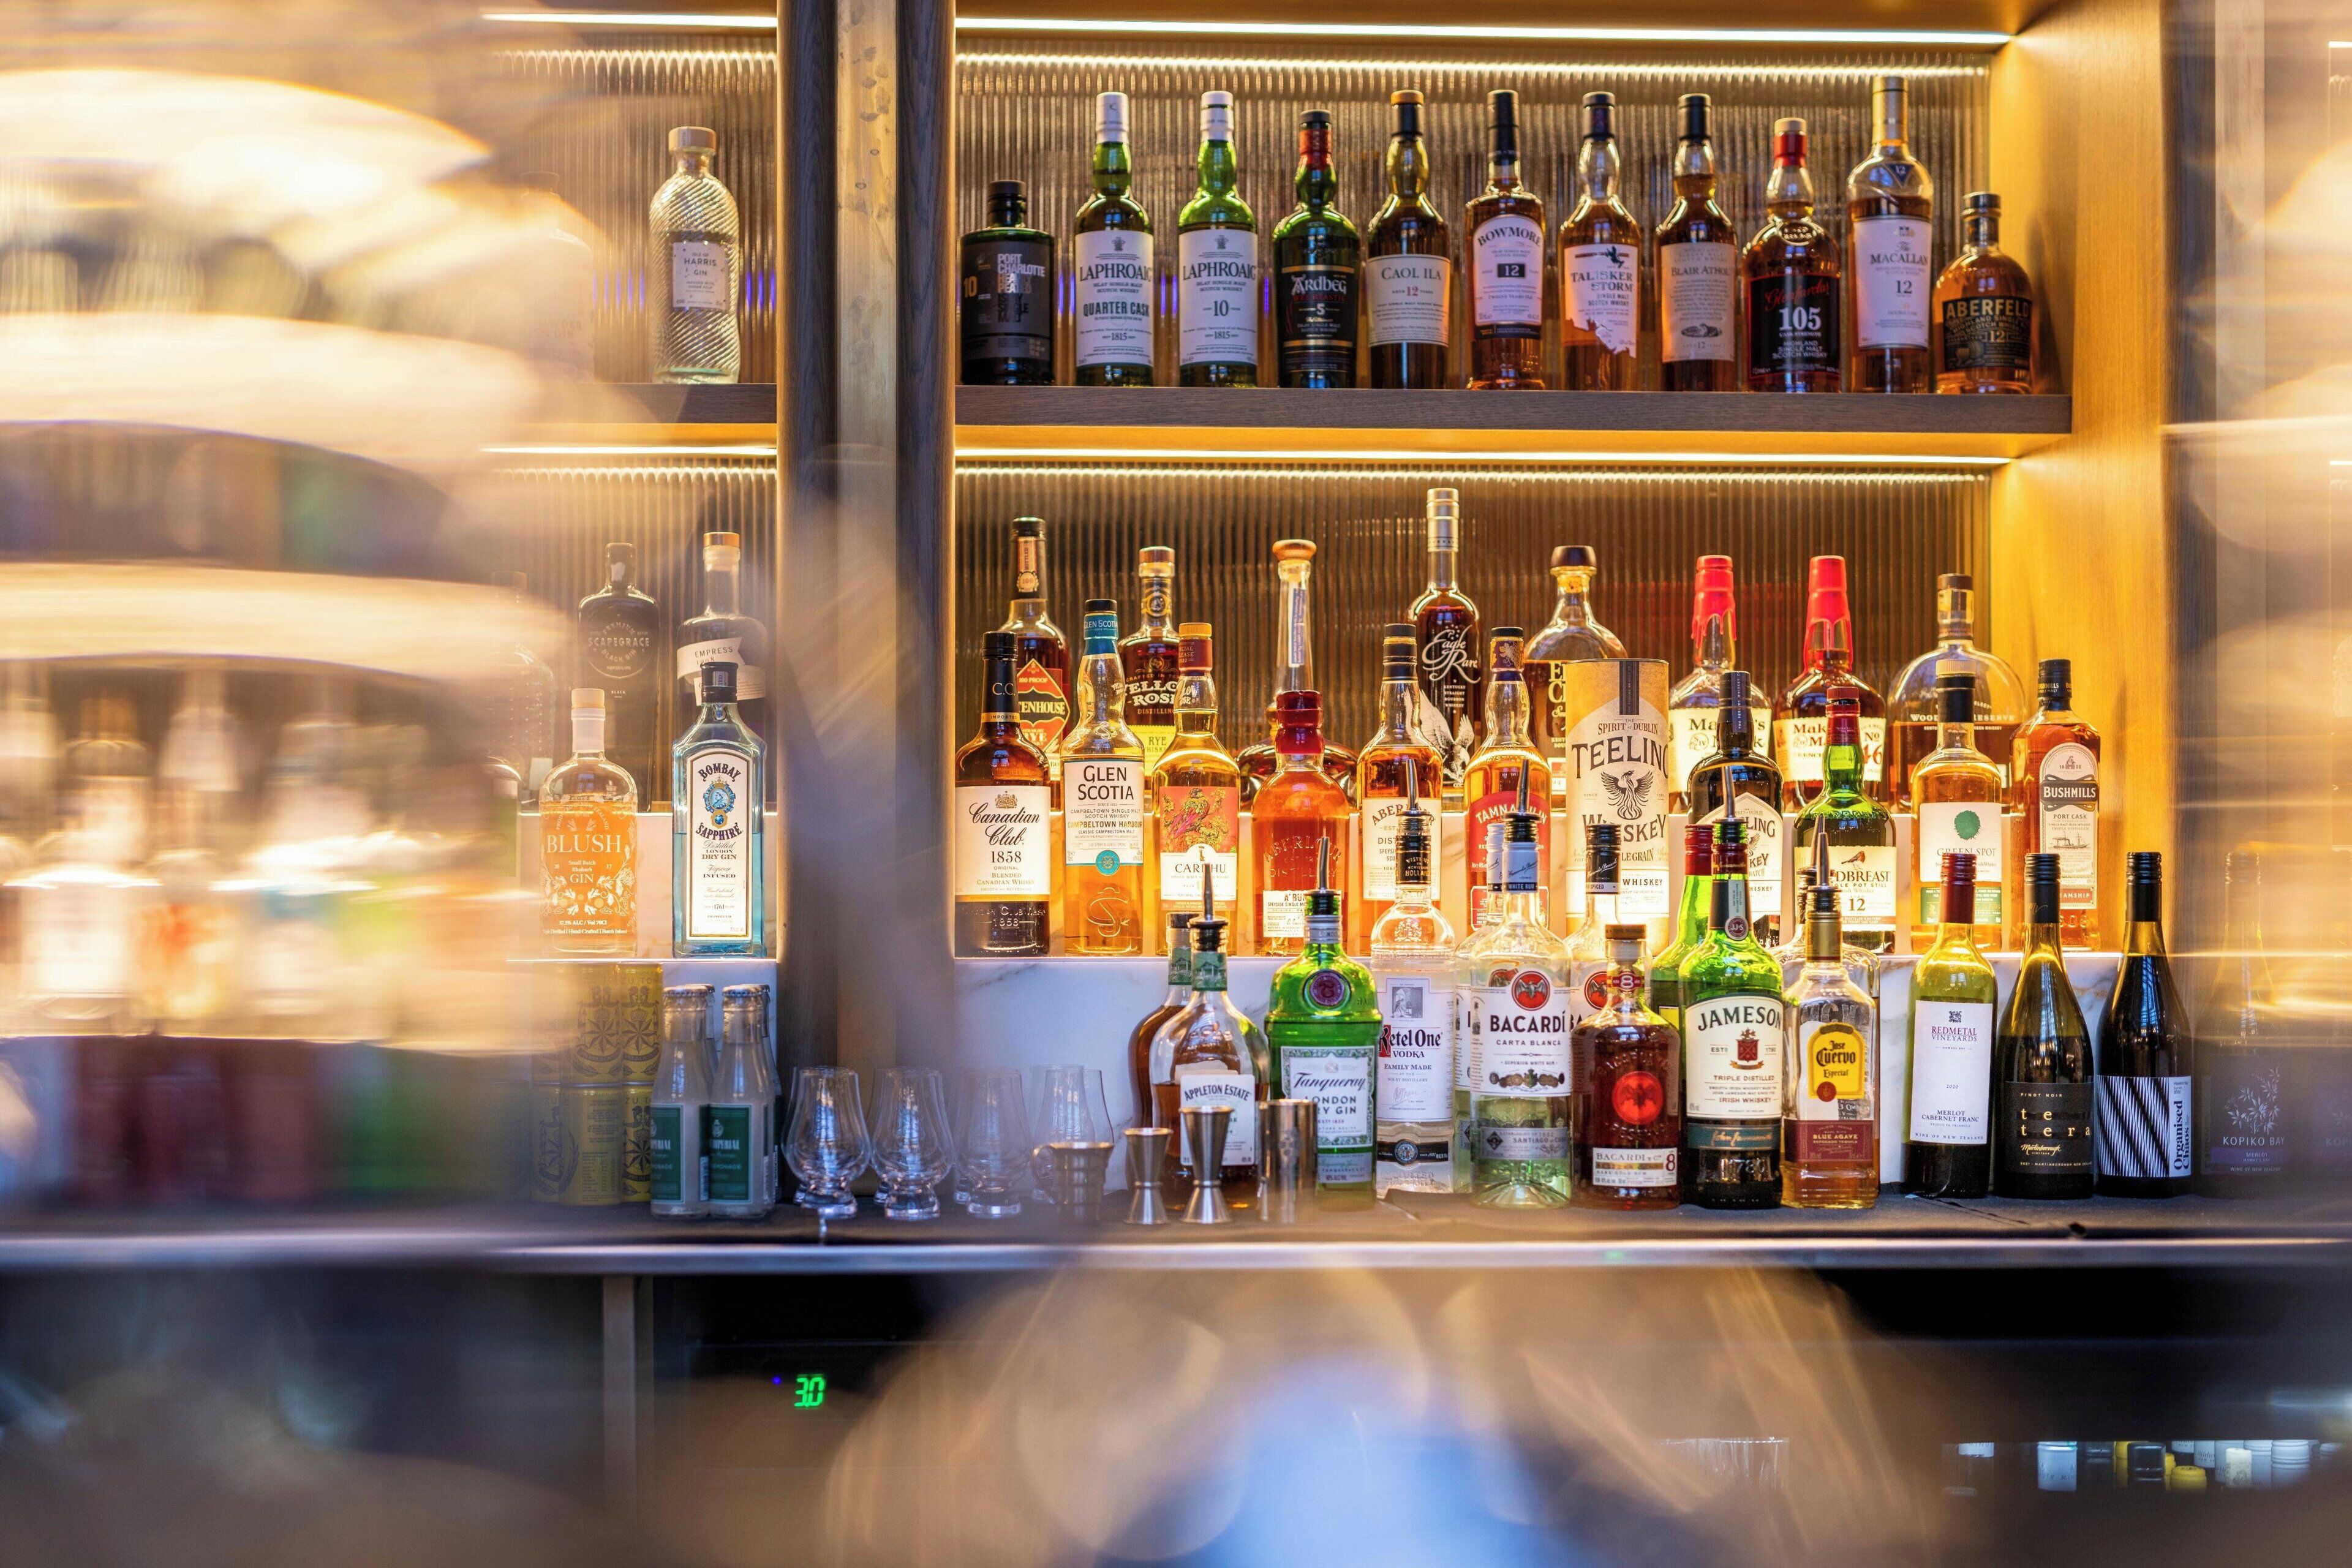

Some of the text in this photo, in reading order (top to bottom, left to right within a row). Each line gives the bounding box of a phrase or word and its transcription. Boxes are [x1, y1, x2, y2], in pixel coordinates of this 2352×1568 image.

[1477, 226, 1541, 247] BOWMORE
[684, 258, 717, 266] HARRIS
[997, 253, 1022, 265] PORT
[997, 263, 1046, 277] CHARLOTTE
[1381, 266, 1442, 281] CAOL ILA
[1504, 265, 1520, 276] 12
[1570, 270, 1634, 283] TALISKER
[1672, 266, 1700, 277] BLAIR
[963, 275, 978, 298] 10
[1406, 286, 1419, 296] 12
[1591, 281, 1634, 293] STORM
[1896, 280, 1913, 294] 12
[1083, 301, 1150, 317] QUARTER CASK
[1213, 300, 1229, 317] 10
[1316, 303, 1326, 315] 5
[1946, 298, 2029, 319] ABERFELD
[1779, 306, 1822, 331] 105
[1111, 333, 1128, 341] 1815
[1213, 331, 1231, 339] 1815
[1990, 330, 2006, 343] 12
[587, 638, 649, 647] SCAPEGRACE
[601, 647, 637, 663] BLACK GIN
[695, 646, 734, 658] EMPRESS
[1126, 674, 1154, 682] CRAFTED
[992, 682, 1016, 696] C.C.
[1598, 722, 1659, 736] SPIRIT DUBLIN
[1148, 736, 1167, 745] RYE
[698, 763, 742, 782] BOMBAY
[1083, 765, 1127, 783] GLEN
[1077, 783, 1134, 801] SCOTIA
[2043, 786, 2096, 798] BUSHMILLS
[968, 802, 1040, 824] Canadian
[695, 822, 743, 841] SAPPHIRE
[1745, 816, 1776, 838] LING
[985, 824, 1024, 846] Club
[547, 834, 622, 854] BLUSH
[703, 840, 735, 850] Distilled
[991, 850, 1022, 864] 1858
[1632, 848, 1654, 862] GRAIN
[1976, 848, 1996, 857] SPOT
[706, 864, 731, 873] Vapour
[570, 873, 594, 884] GIN
[1849, 898, 1866, 911] 12
[1620, 972, 1634, 990] 8
[1490, 1009, 1566, 1033] BACARDÍ
[1697, 1005, 1782, 1031] JAMESON
[1931, 1026, 1978, 1036] REDMETAL
[1378, 1025, 1441, 1056] Ketel One
[1829, 1040, 1846, 1052] Jose
[1392, 1050, 1425, 1058] VODKA
[1815, 1047, 1856, 1067] Cuervo
[1823, 1068, 1850, 1079] Especial
[1292, 1072, 1367, 1092] Tanqueray
[1183, 1084, 1251, 1101] APPLETON ESTATE
[1335, 1106, 1357, 1115] GIN
[2173, 1100, 2183, 1170] Organised
[2222, 1136, 2285, 1147] KOPIKO BAY
[1596, 1152, 1646, 1161] BACARDI
[2021, 1144, 2062, 1156] Martinborough
[1665, 1153, 1676, 1172] 8
